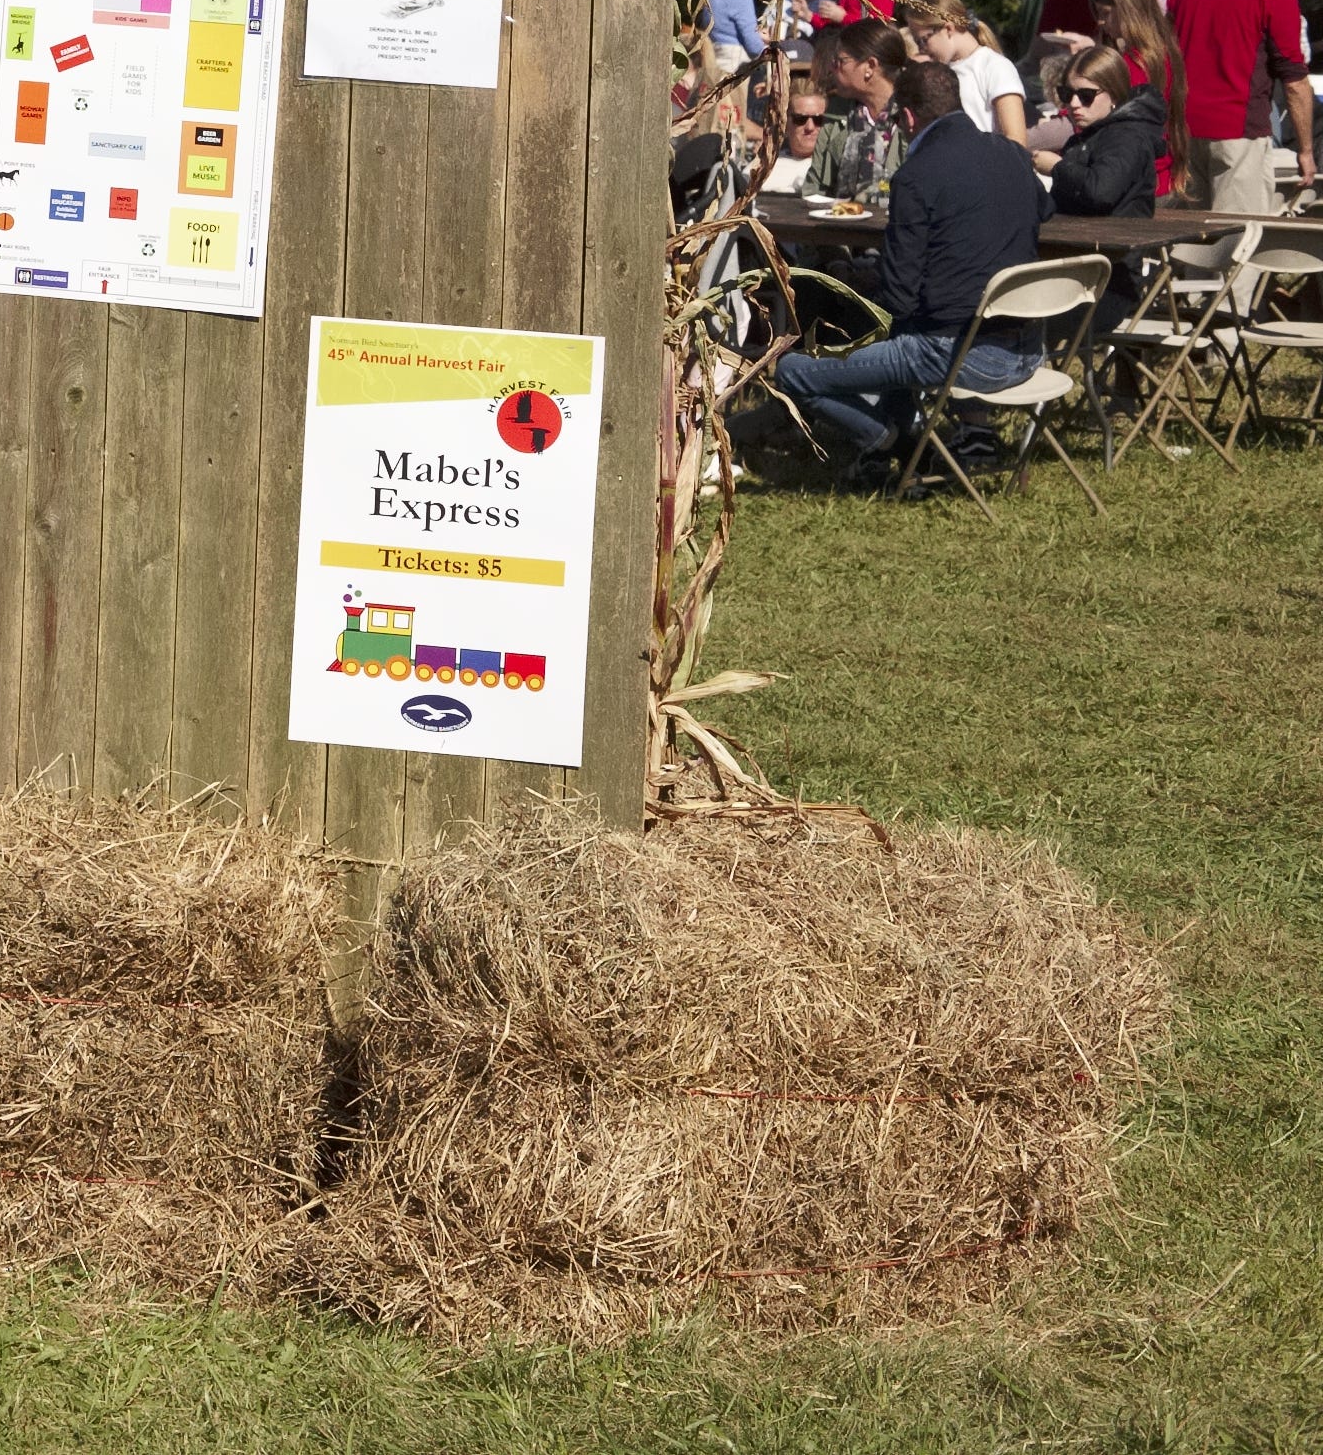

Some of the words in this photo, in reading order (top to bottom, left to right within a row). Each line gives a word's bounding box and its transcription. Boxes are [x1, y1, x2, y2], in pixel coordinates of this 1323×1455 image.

[187, 222, 220, 233] FOOD!
[359, 351, 411, 367] Annual
[417, 354, 473, 371] Harvest
[478, 359, 505, 373] Fair
[487, 380, 547, 413] HARVEST
[549, 389, 572, 419] FAIR
[373, 449, 520, 490] Mabel's
[369, 486, 520, 532] Express
[378, 548, 469, 575] Tickets:
[477, 558, 503, 577] $5
